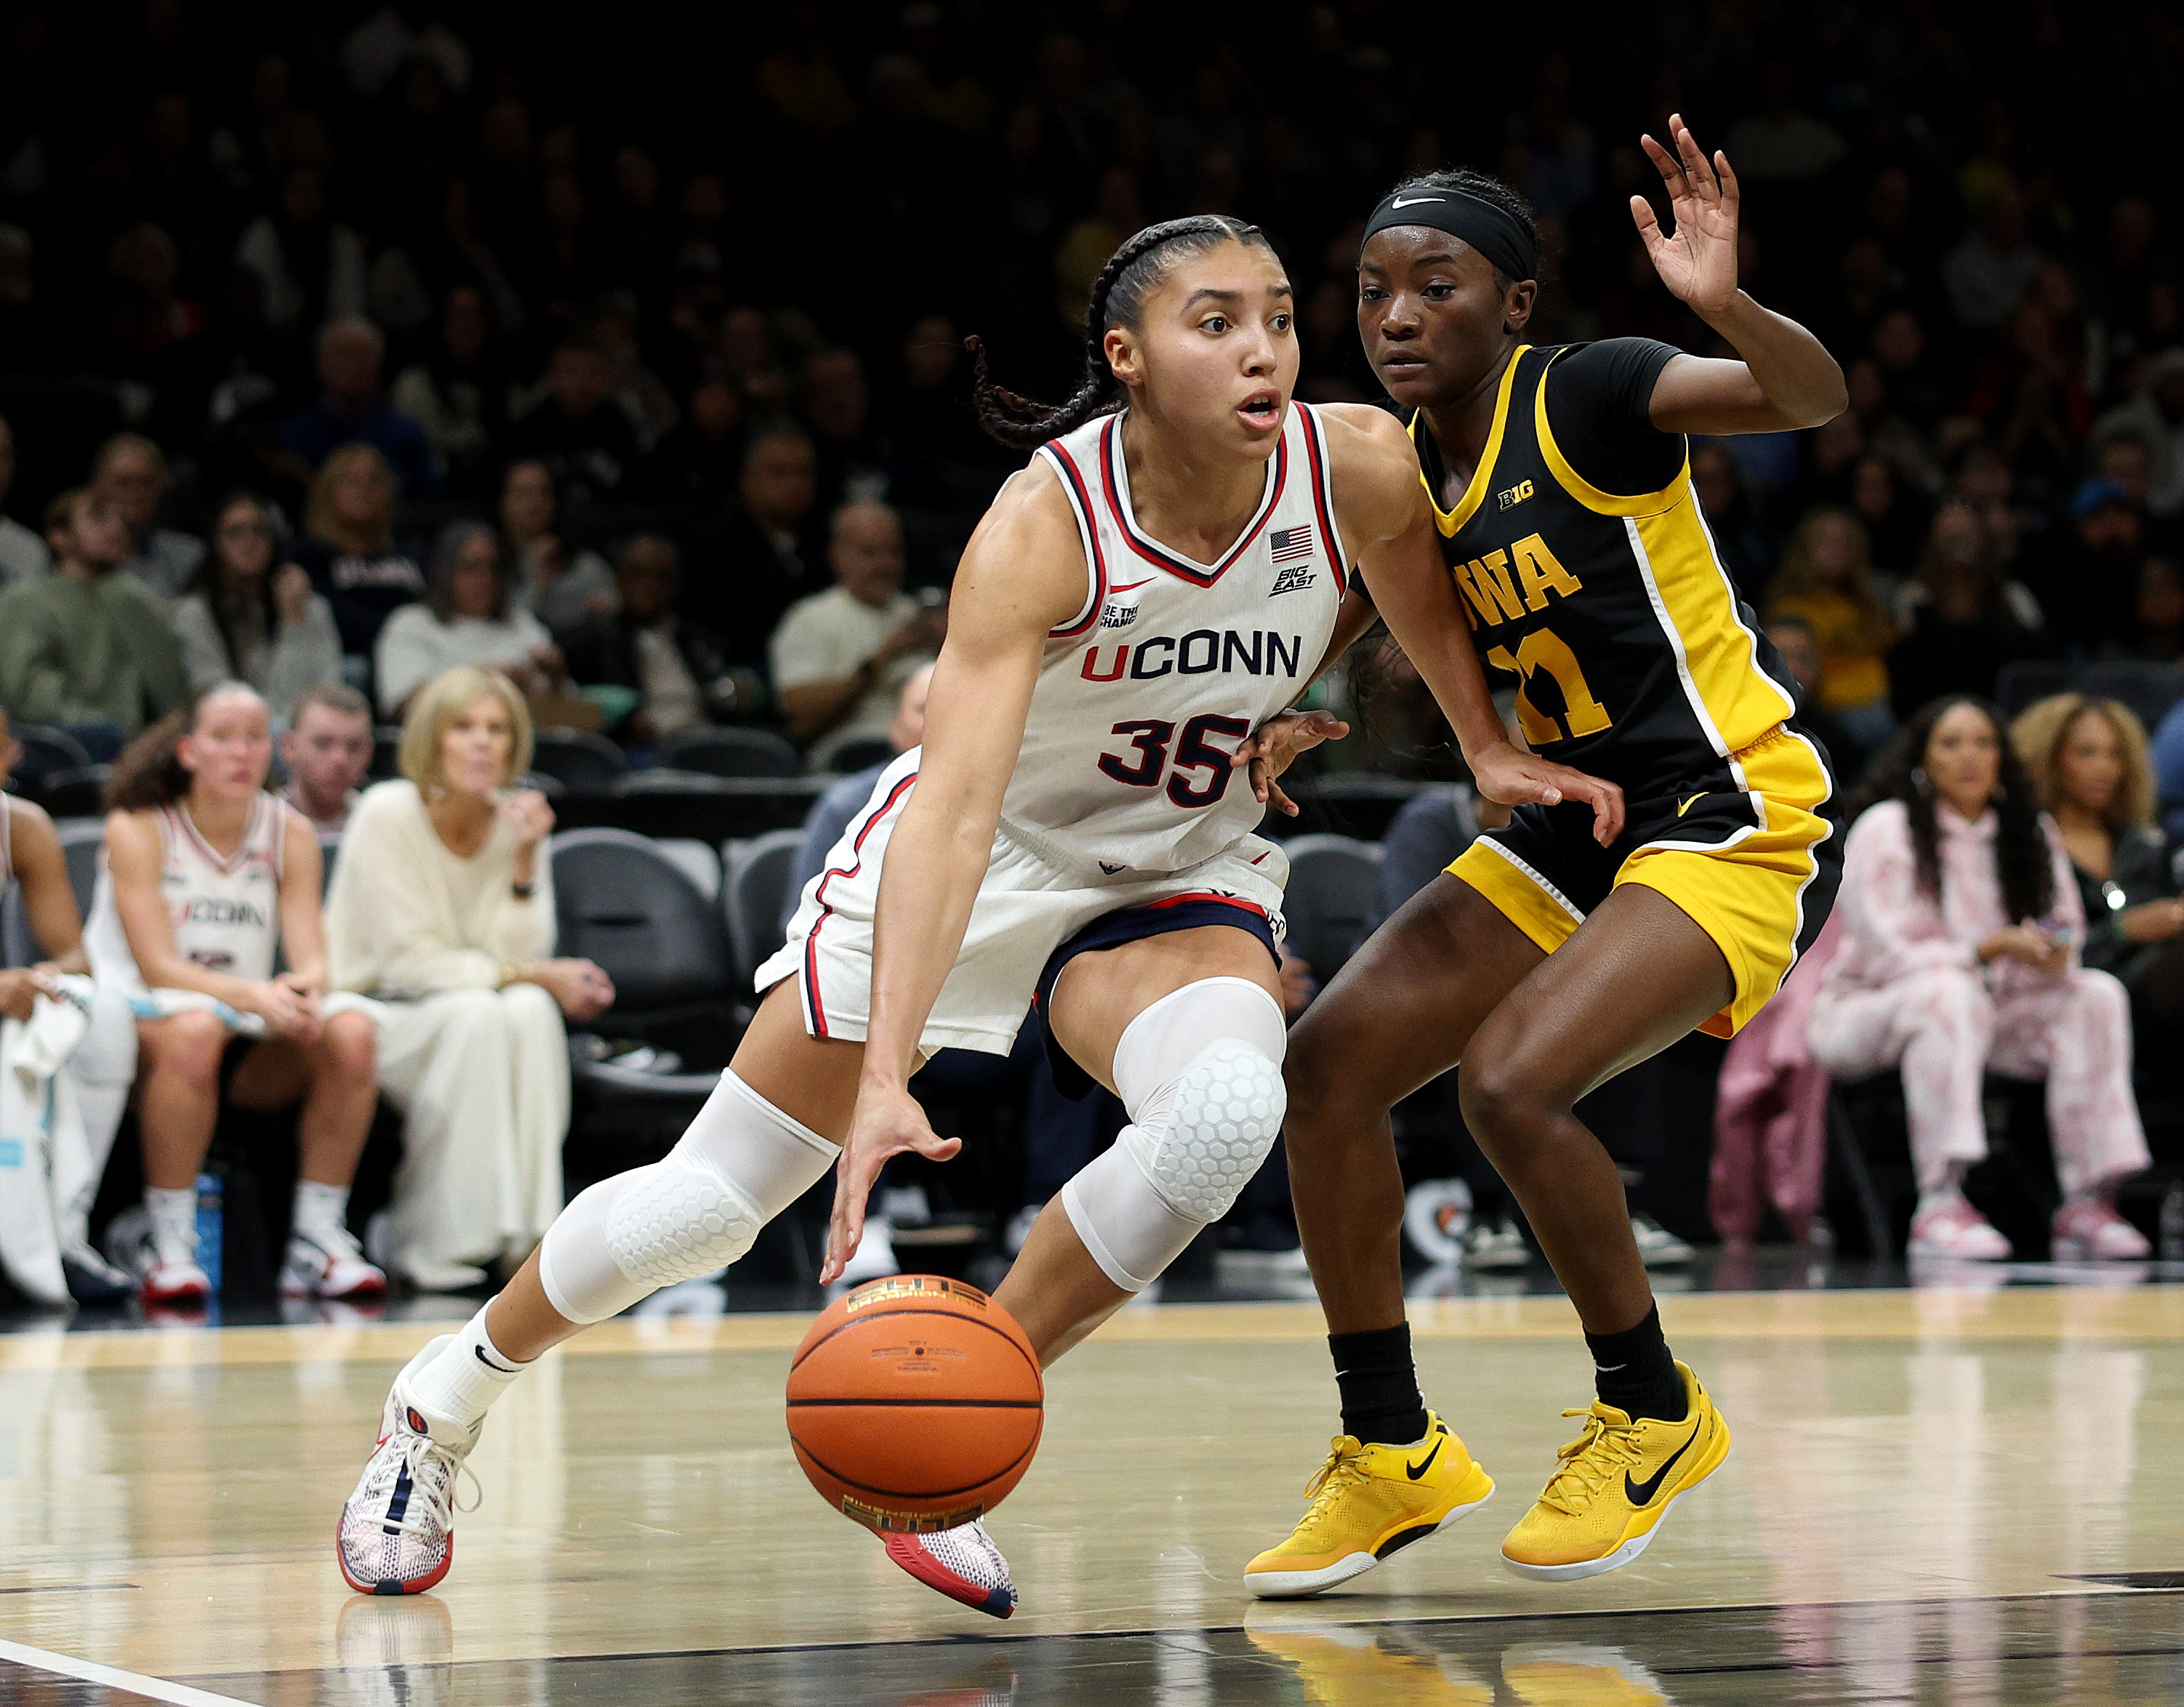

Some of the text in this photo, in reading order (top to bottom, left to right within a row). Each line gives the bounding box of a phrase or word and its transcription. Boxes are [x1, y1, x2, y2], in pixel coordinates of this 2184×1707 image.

[1272, 574, 1317, 592] EAST
[1277, 564, 1309, 582] BIG
[1453, 532, 1583, 630] WA
[1100, 614, 1139, 628] HANG
[1104, 604, 1117, 617] BE
[1080, 629, 1302, 683] UCONN
[1487, 627, 1613, 745] 11
[1097, 713, 1251, 809] 35
